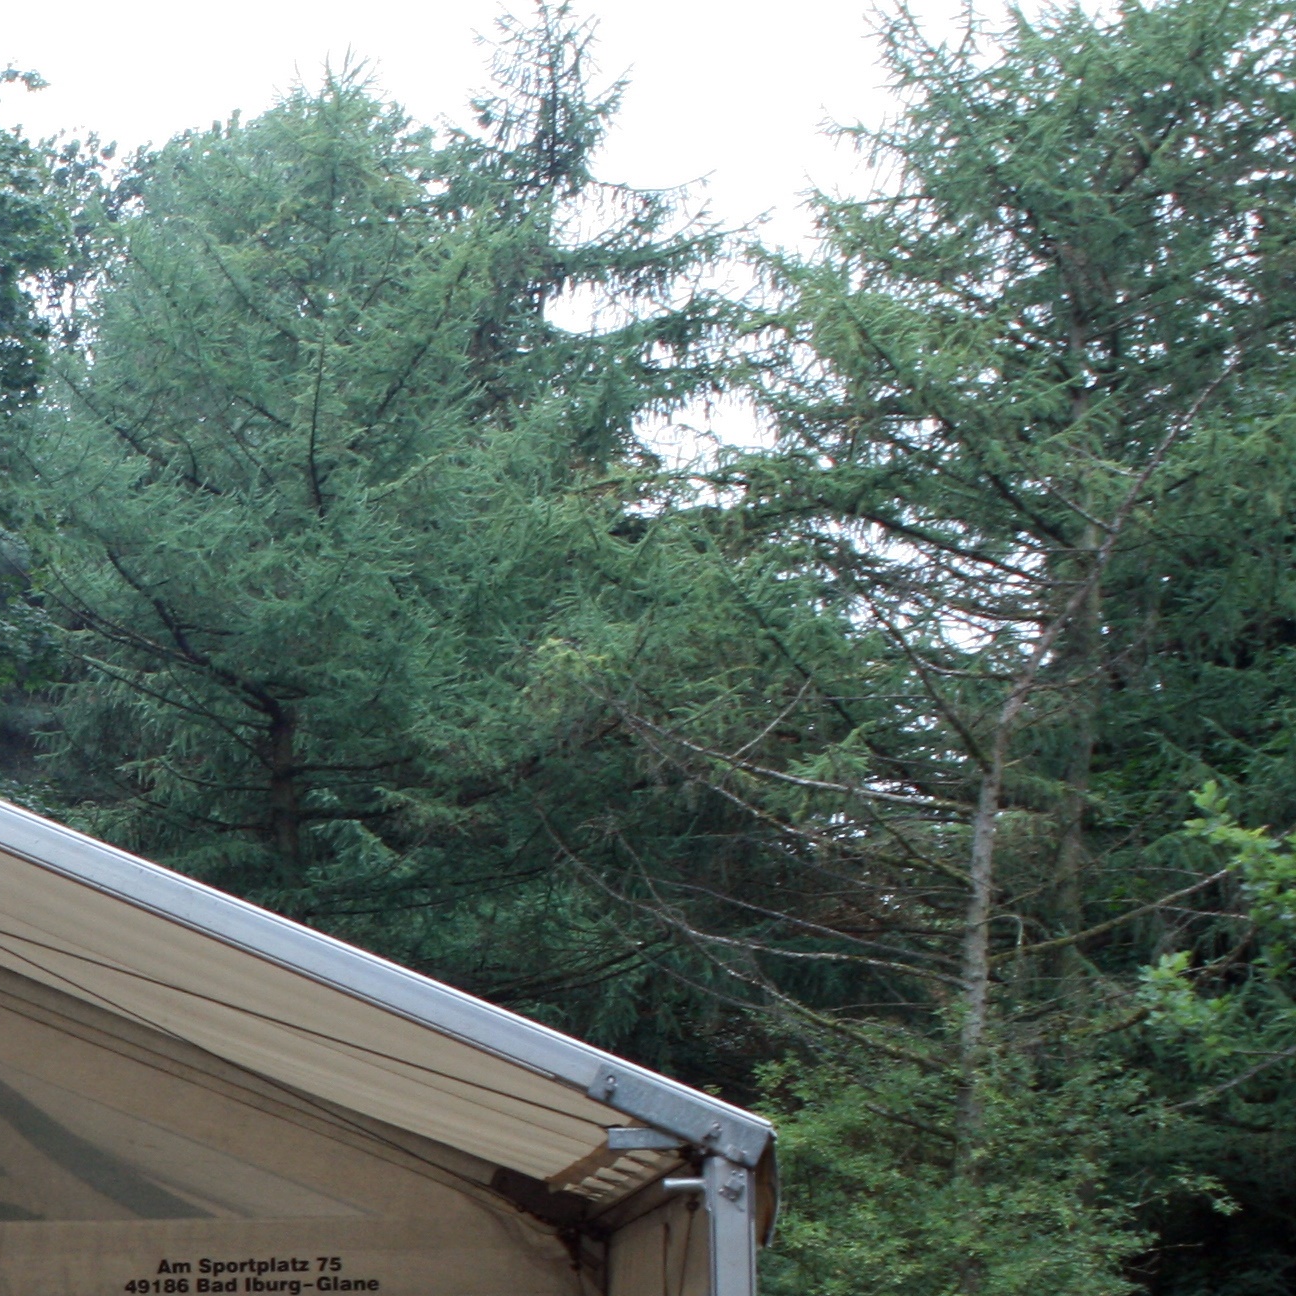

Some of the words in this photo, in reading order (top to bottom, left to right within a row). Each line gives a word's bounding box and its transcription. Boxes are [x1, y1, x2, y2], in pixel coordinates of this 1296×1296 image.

[157, 1258, 192, 1275] Am
[198, 1256, 310, 1277] Sportplatz
[316, 1256, 342, 1272] 75
[124, 1278, 190, 1294] 49186
[196, 1277, 238, 1293] Bad
[244, 1275, 380, 1296] Iburg-Glane
